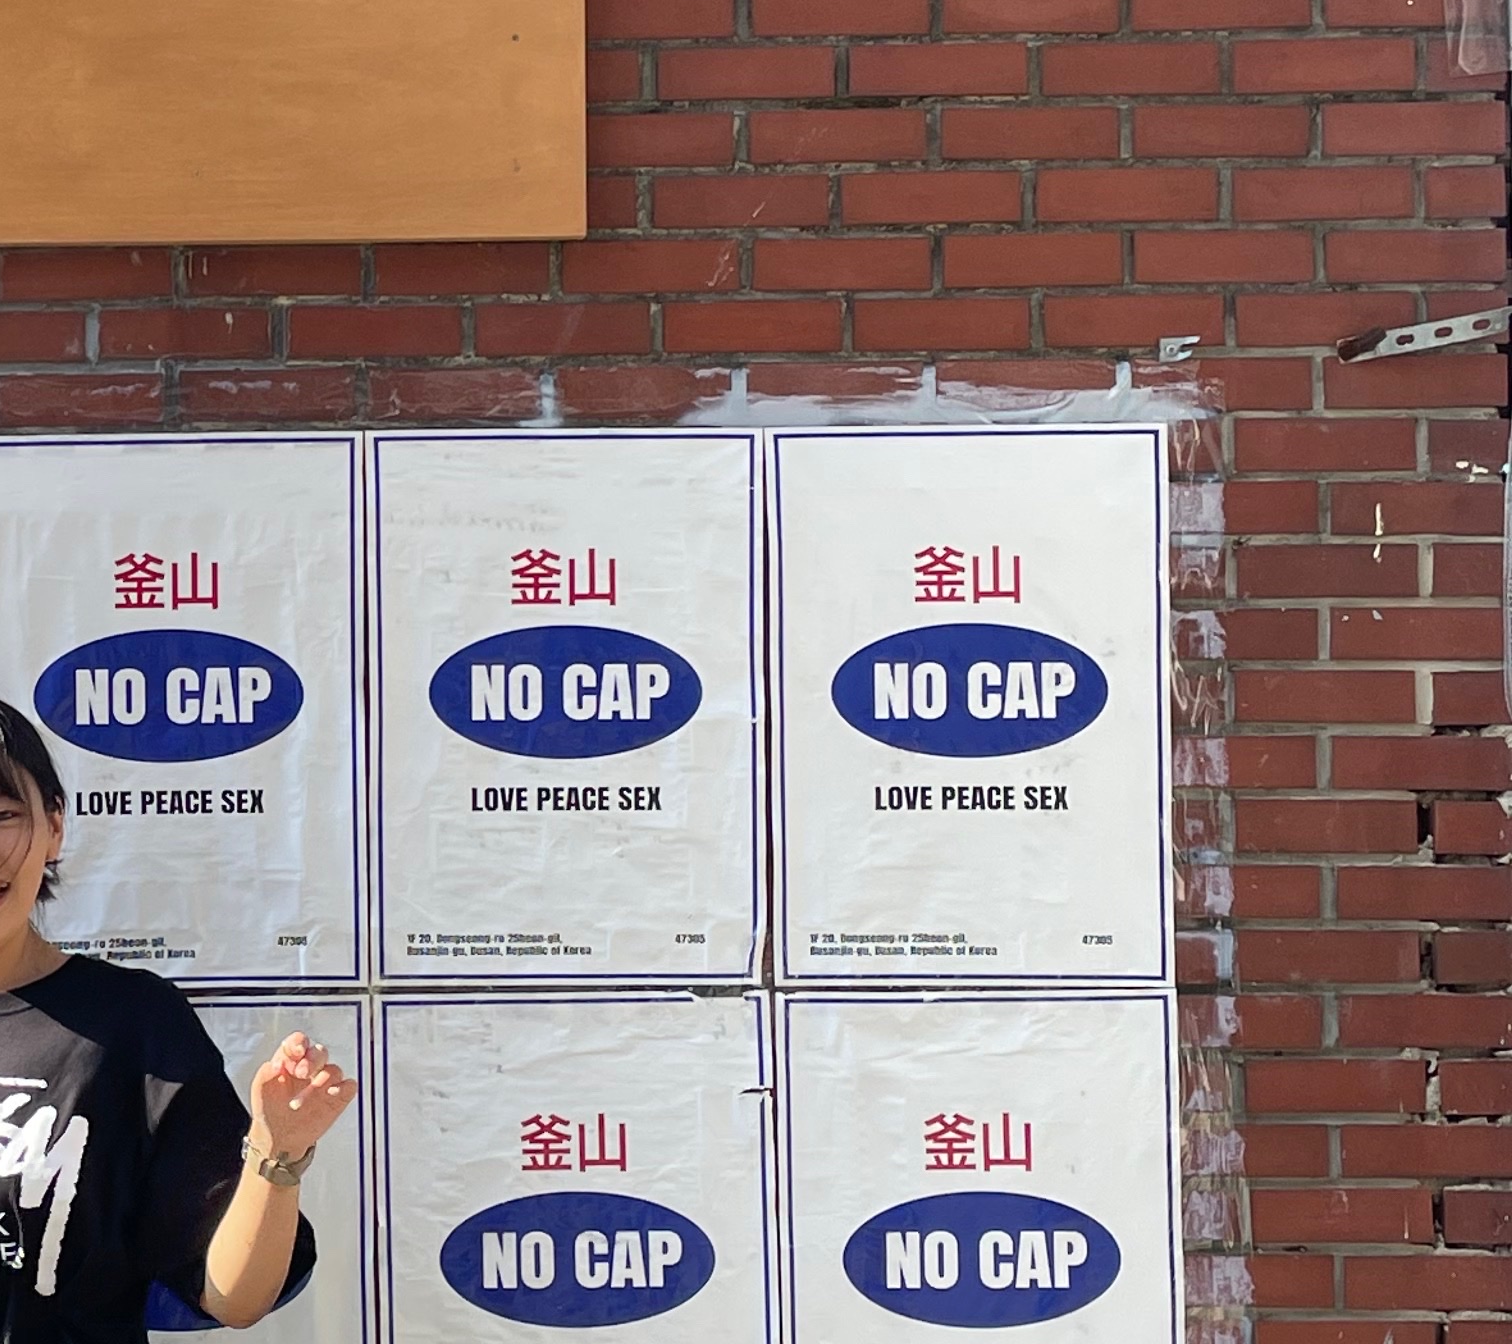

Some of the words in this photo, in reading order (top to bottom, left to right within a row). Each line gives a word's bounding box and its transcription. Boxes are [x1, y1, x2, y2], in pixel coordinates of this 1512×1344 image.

[115, 552, 219, 609] 釜山
[512, 549, 617, 605] 釜山
[915, 546, 1021, 603] 釜山
[75, 668, 146, 725] NO
[166, 667, 272, 724] CAP
[471, 663, 543, 721] NO
[562, 663, 670, 721] CAP
[873, 661, 947, 720] NO
[967, 661, 1076, 720] CAP
[75, 790, 133, 817] LOVE
[140, 789, 214, 816] PEACE
[220, 788, 265, 815] SEX
[471, 787, 528, 812] LOVE
[537, 786, 609, 811] PEACE
[618, 786, 661, 811] SEX
[875, 786, 932, 811] LOVE
[941, 786, 1015, 810] PEACE
[1024, 786, 1068, 810] SEX
[564, 945, 592, 955] Korea
[969, 946, 997, 956] Korea
[522, 1114, 627, 1171] 釜山
[926, 1113, 1033, 1170] 釜山
[482, 1231, 555, 1289] NO
[574, 1230, 683, 1289] CAP
[885, 1230, 959, 1290] NO
[978, 1230, 1088, 1289] CAP
